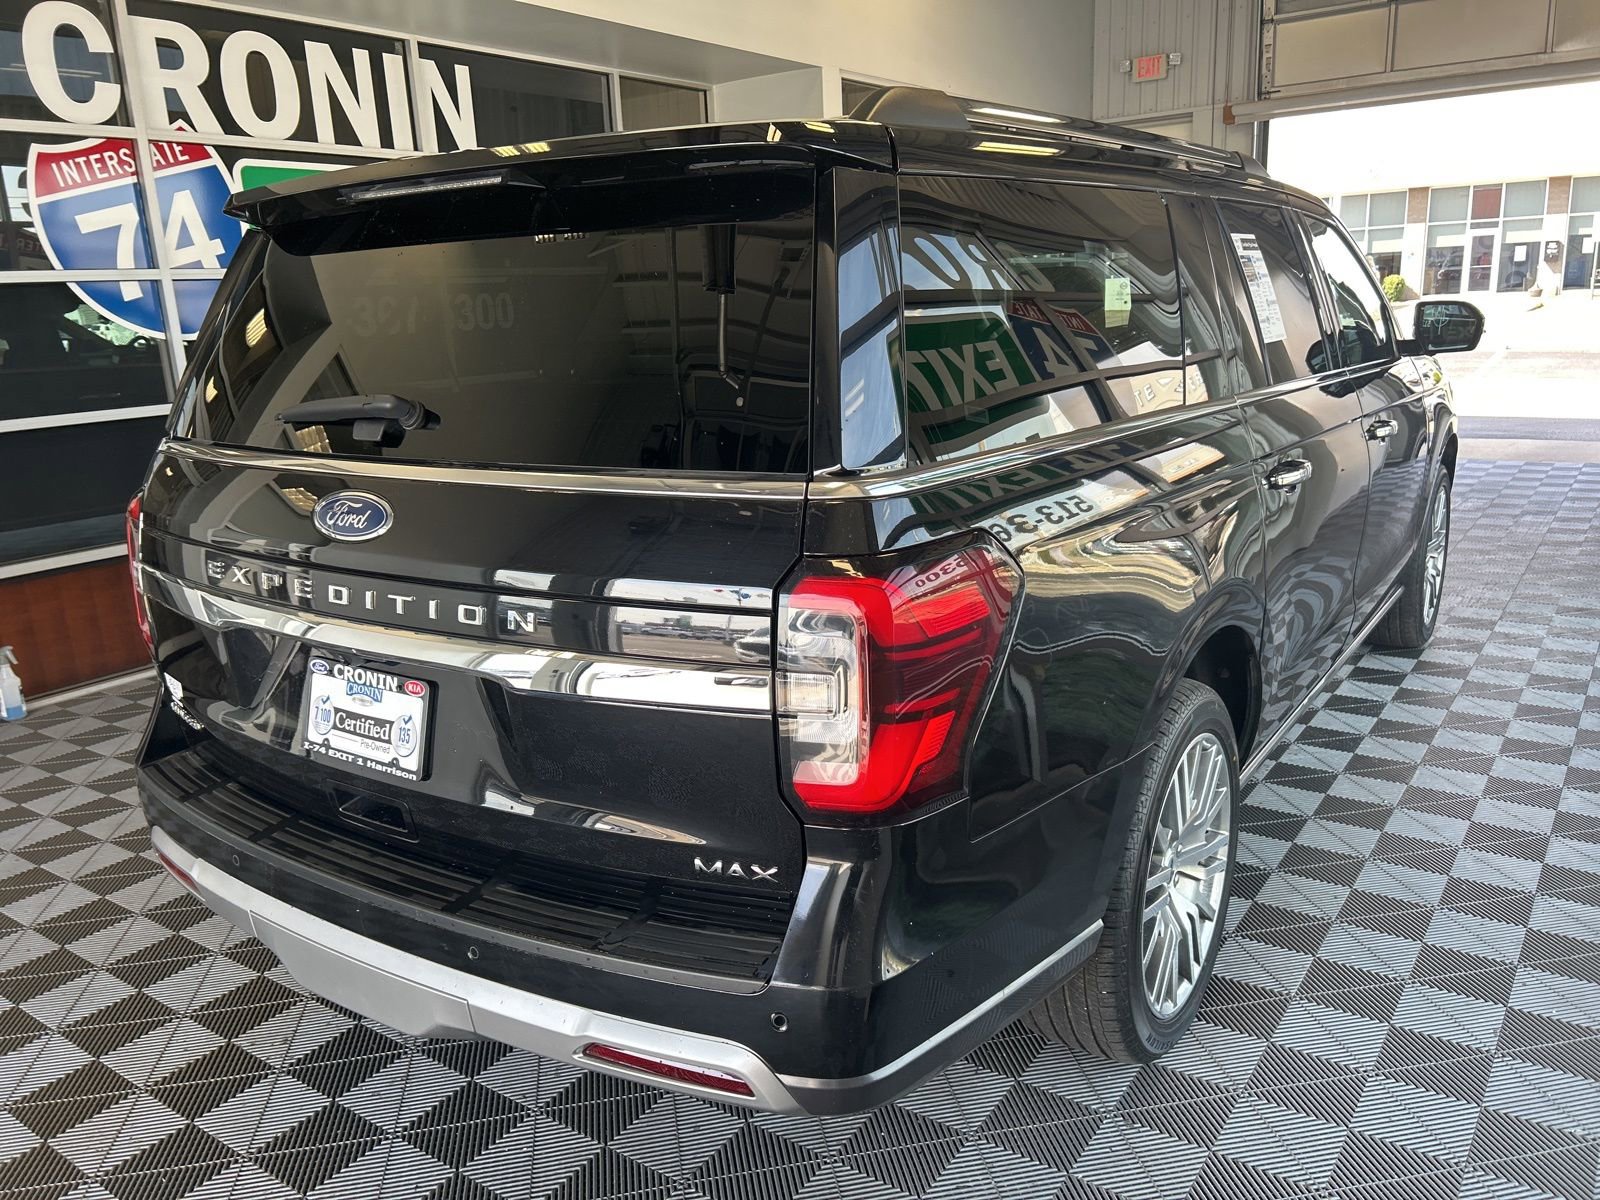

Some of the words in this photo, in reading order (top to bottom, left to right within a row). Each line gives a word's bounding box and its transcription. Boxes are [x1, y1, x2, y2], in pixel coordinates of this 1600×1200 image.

[22, 0, 478, 152] CRONIN
[1137, 55, 1162, 78] EXIT
[51, 142, 189, 188] INTERSATE
[74, 190, 226, 302] 74
[326, 500, 372, 529] Ford
[207, 559, 538, 633] EXPEDITION
[333, 663, 398, 692] CRONIN
[347, 682, 382, 702] CRONIN
[335, 711, 390, 740] Certified
[398, 726, 411, 744] 135
[303, 741, 327, 754] I-74
[328, 748, 355, 762] EXIT
[366, 761, 417, 781] Harrison
[360, 739, 391, 754] Pre-Owned
[693, 856, 779, 883] MAX
